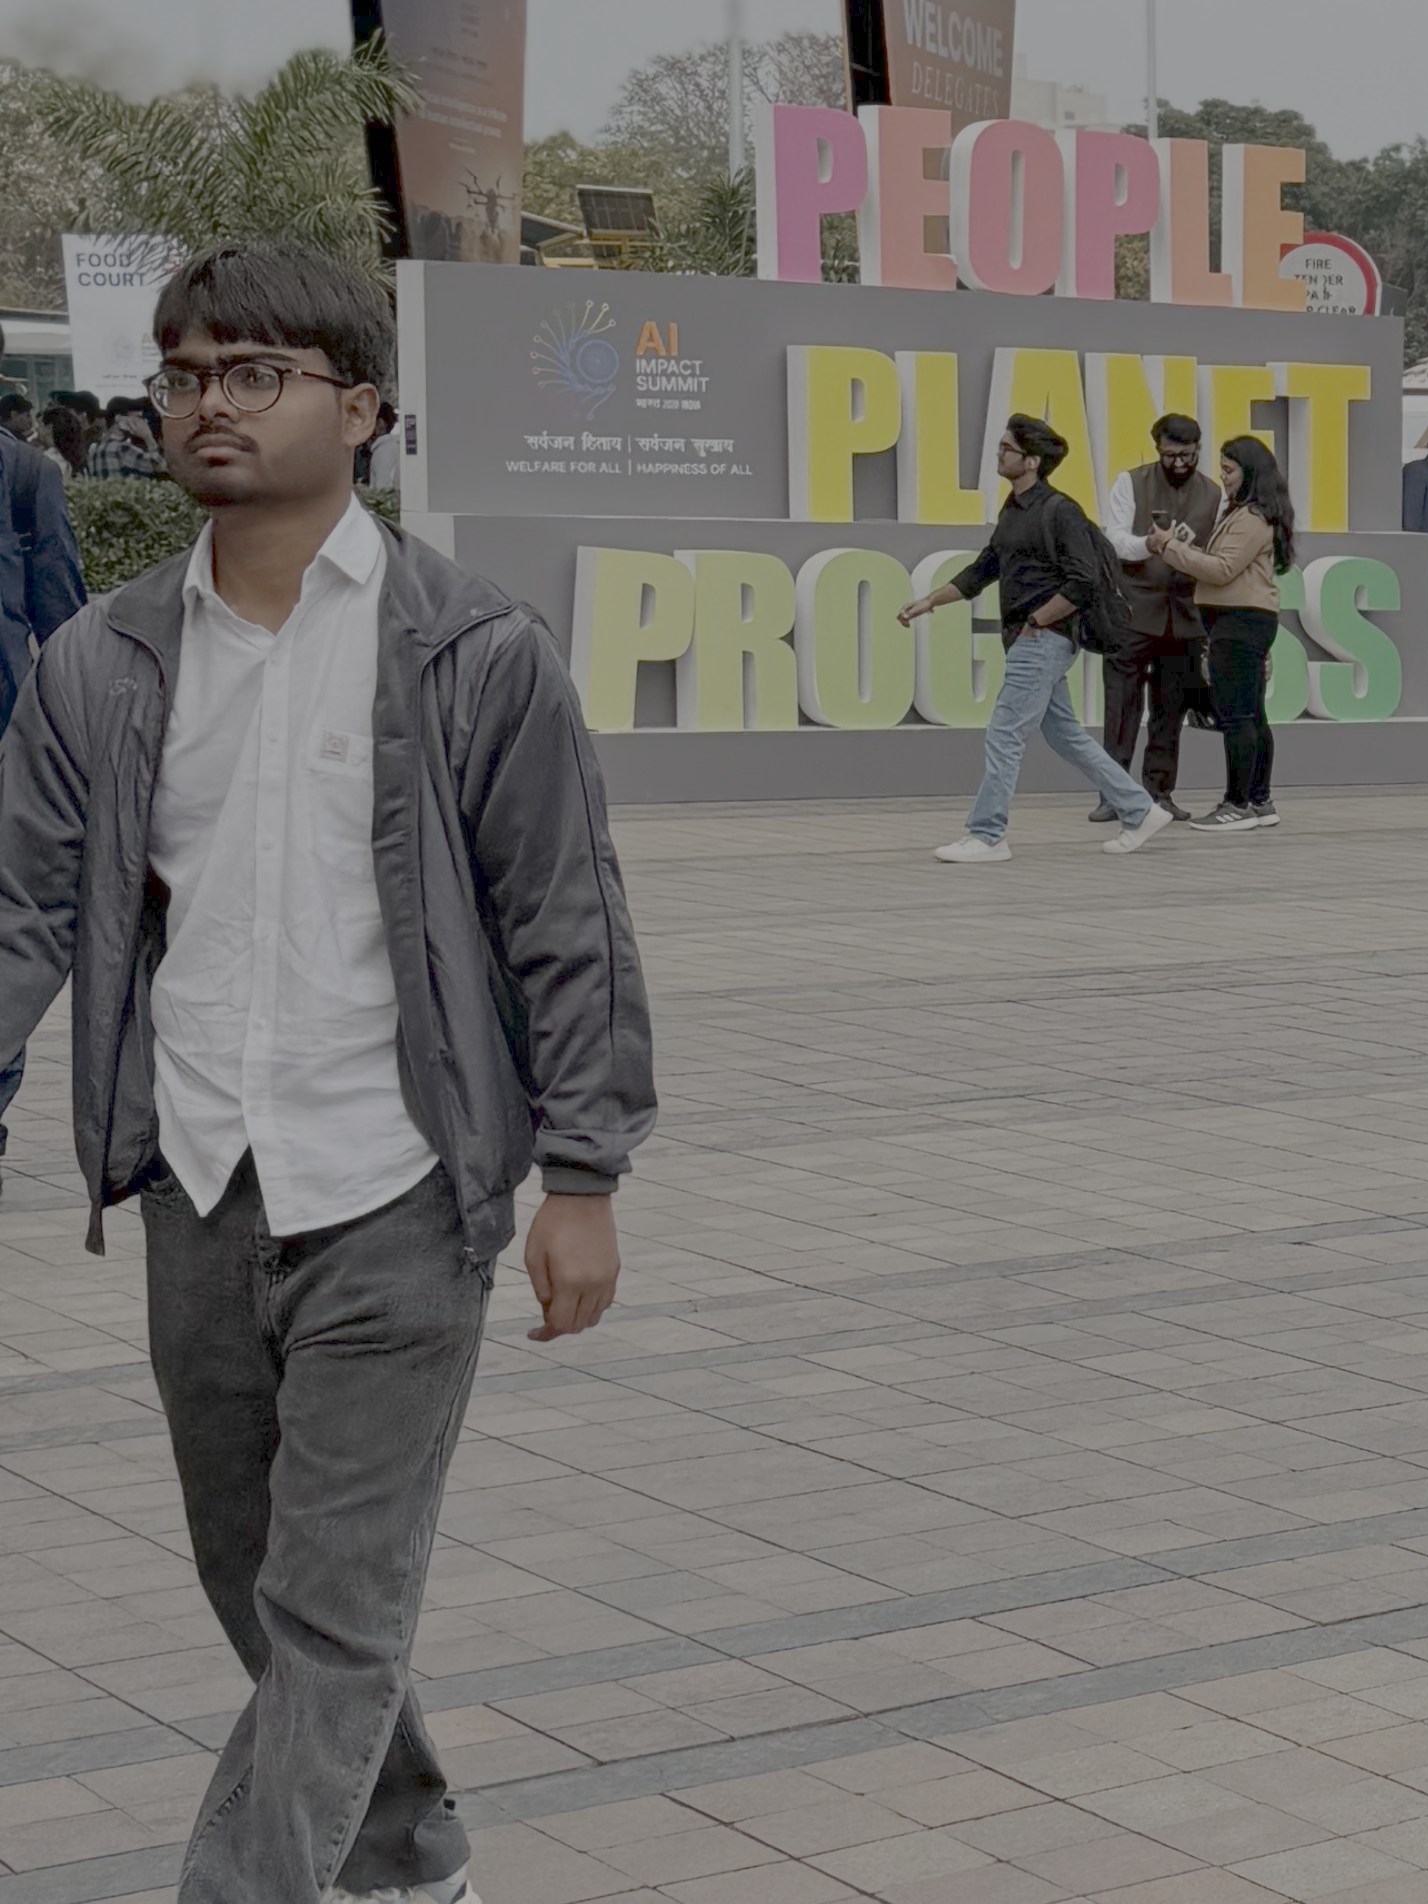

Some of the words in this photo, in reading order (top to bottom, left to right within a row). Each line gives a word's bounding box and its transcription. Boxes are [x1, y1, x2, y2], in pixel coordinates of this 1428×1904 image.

[911, 60, 1000, 118] DELEGATES
[758, 104, 1307, 312] PEOPLE
[75, 252, 131, 268] FOOD
[1305, 258, 1332, 270] FIRE
[78, 272, 145, 287] COURT
[635, 321, 679, 357] AI
[635, 359, 703, 376] IMPACT
[636, 376, 710, 393] SUMMIT
[506, 461, 567, 473] WELFARE
[570, 461, 597, 473] FOR
[599, 462, 622, 474] ALL
[636, 463, 708, 475] HAPPINESS
[710, 464, 727, 475] OF
[730, 464, 753, 476] ALL
[572, 546, 1402, 732] PROGS
